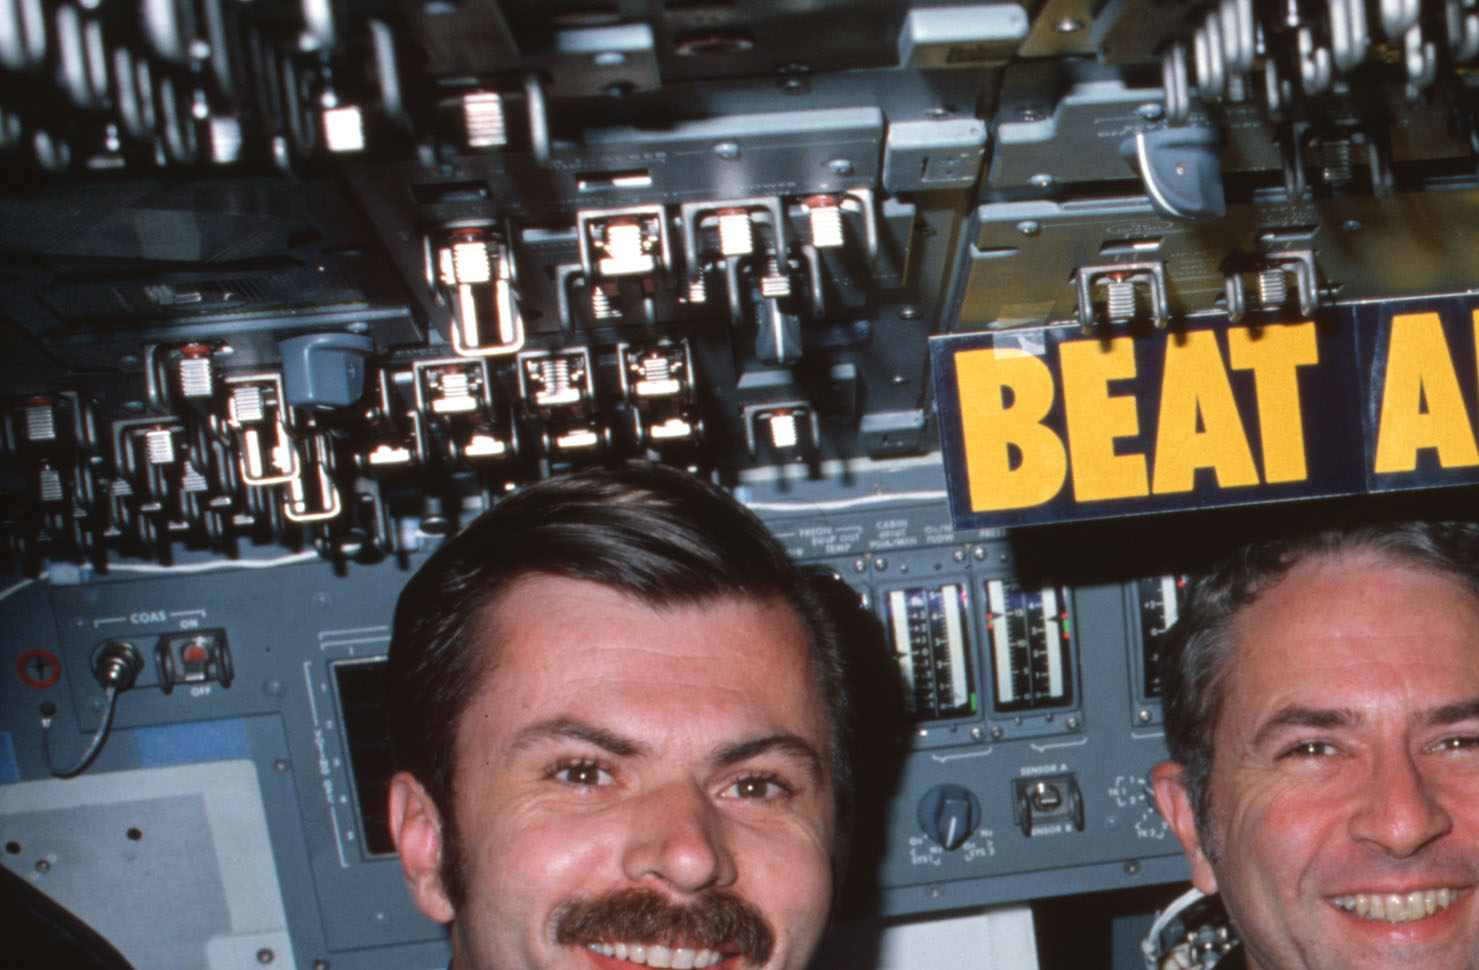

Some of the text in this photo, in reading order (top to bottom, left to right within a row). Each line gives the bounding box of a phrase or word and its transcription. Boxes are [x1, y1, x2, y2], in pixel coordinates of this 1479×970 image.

[954, 322, 1319, 513] BEAT
[130, 610, 167, 624] COAS
[179, 618, 199, 629] ON
[190, 685, 212, 697] OFF
[1020, 763, 1068, 776] SENSOR A
[1031, 825, 1062, 837] ENSOR
